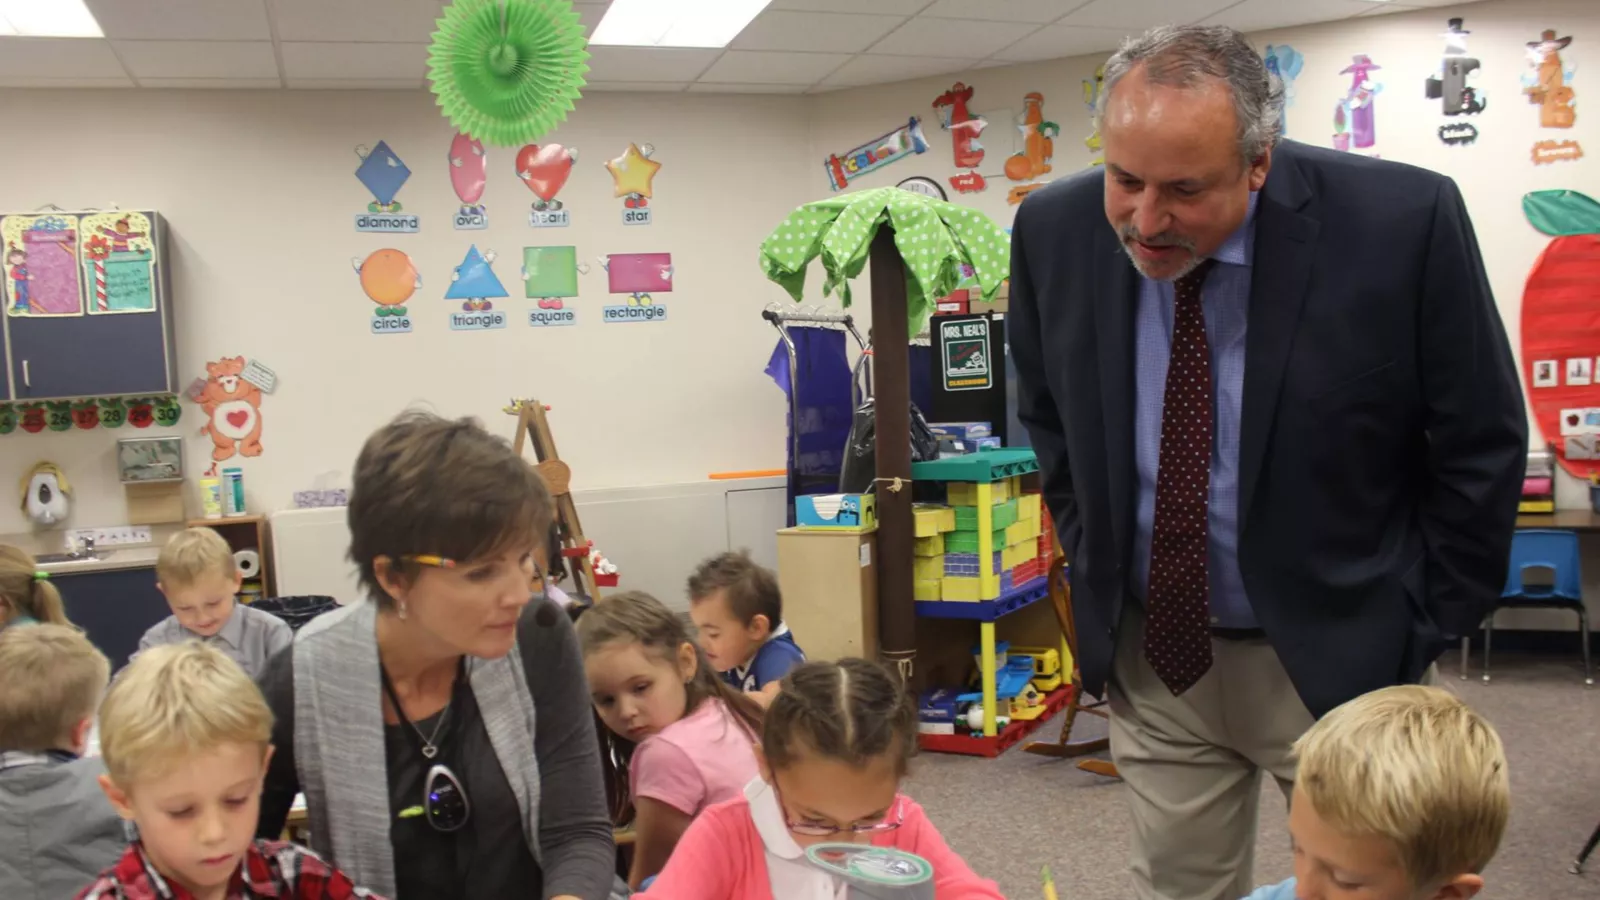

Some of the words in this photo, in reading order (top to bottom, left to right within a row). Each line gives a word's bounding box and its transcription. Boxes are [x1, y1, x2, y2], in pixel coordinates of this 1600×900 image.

[959, 177, 974, 185] red
[357, 216, 418, 229] diamond
[456, 214, 484, 226] oval
[531, 211, 567, 224] heart
[625, 211, 648, 222] star
[530, 311, 574, 325] square
[604, 306, 665, 320] rectangle
[373, 318, 410, 330] circle
[453, 314, 503, 328] triangle
[944, 326, 962, 338] MRS.
[51, 412, 66, 426] 26
[78, 411, 94, 425] 27
[103, 409, 121, 423] 28
[157, 407, 177, 421] 30
